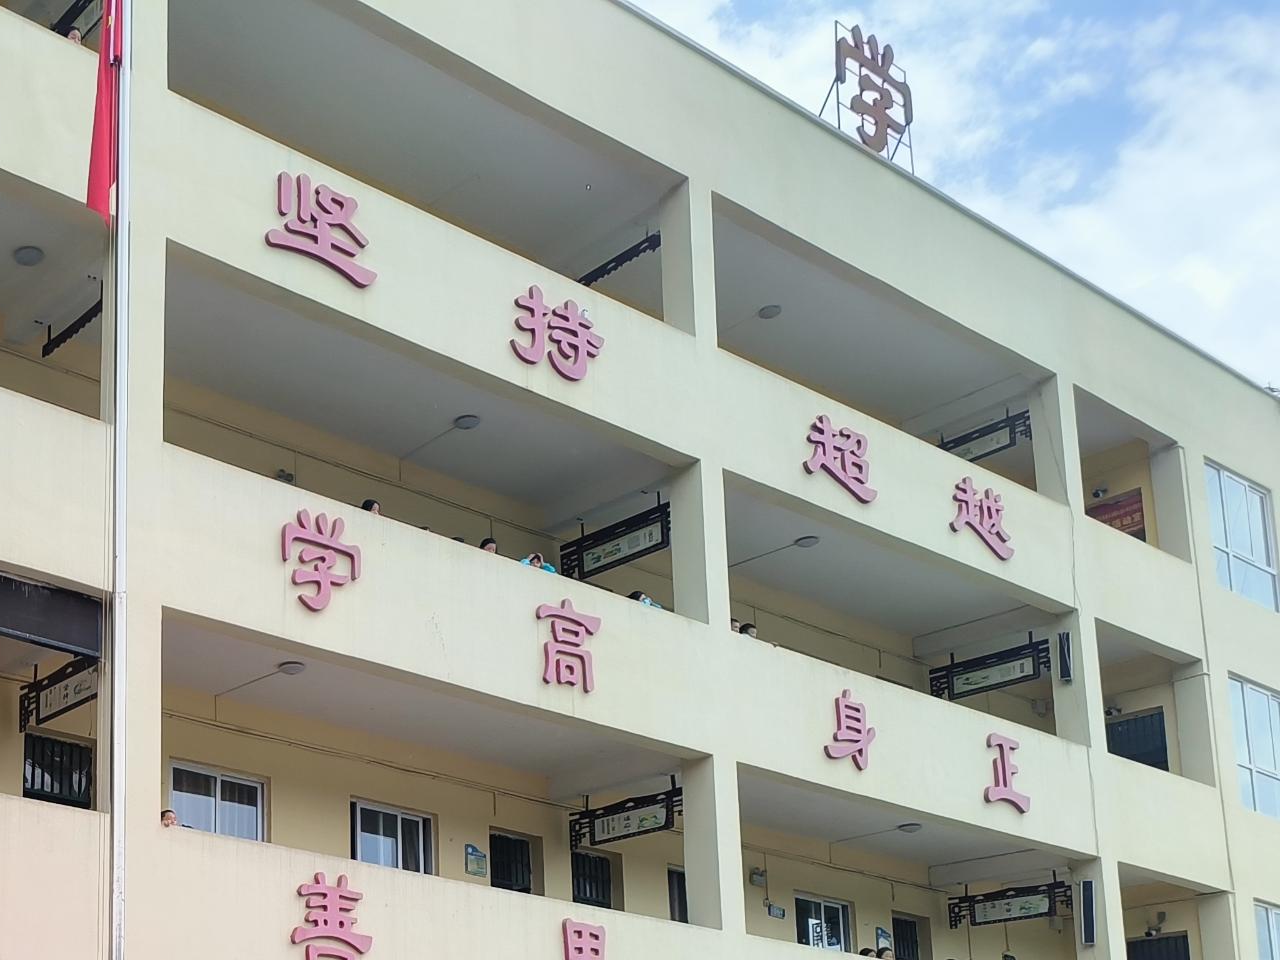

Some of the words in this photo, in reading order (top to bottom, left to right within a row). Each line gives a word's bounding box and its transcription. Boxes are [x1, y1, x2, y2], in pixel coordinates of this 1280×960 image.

[835, 25, 913, 154] 学
[265, 171, 377, 288] 坚
[510, 285, 604, 381] 持
[803, 415, 877, 504] 超
[950, 476, 1014, 560] 越
[281, 508, 361, 612] 学
[535, 598, 601, 693] 高
[824, 689, 876, 770] 身
[984, 733, 1030, 813] 正
